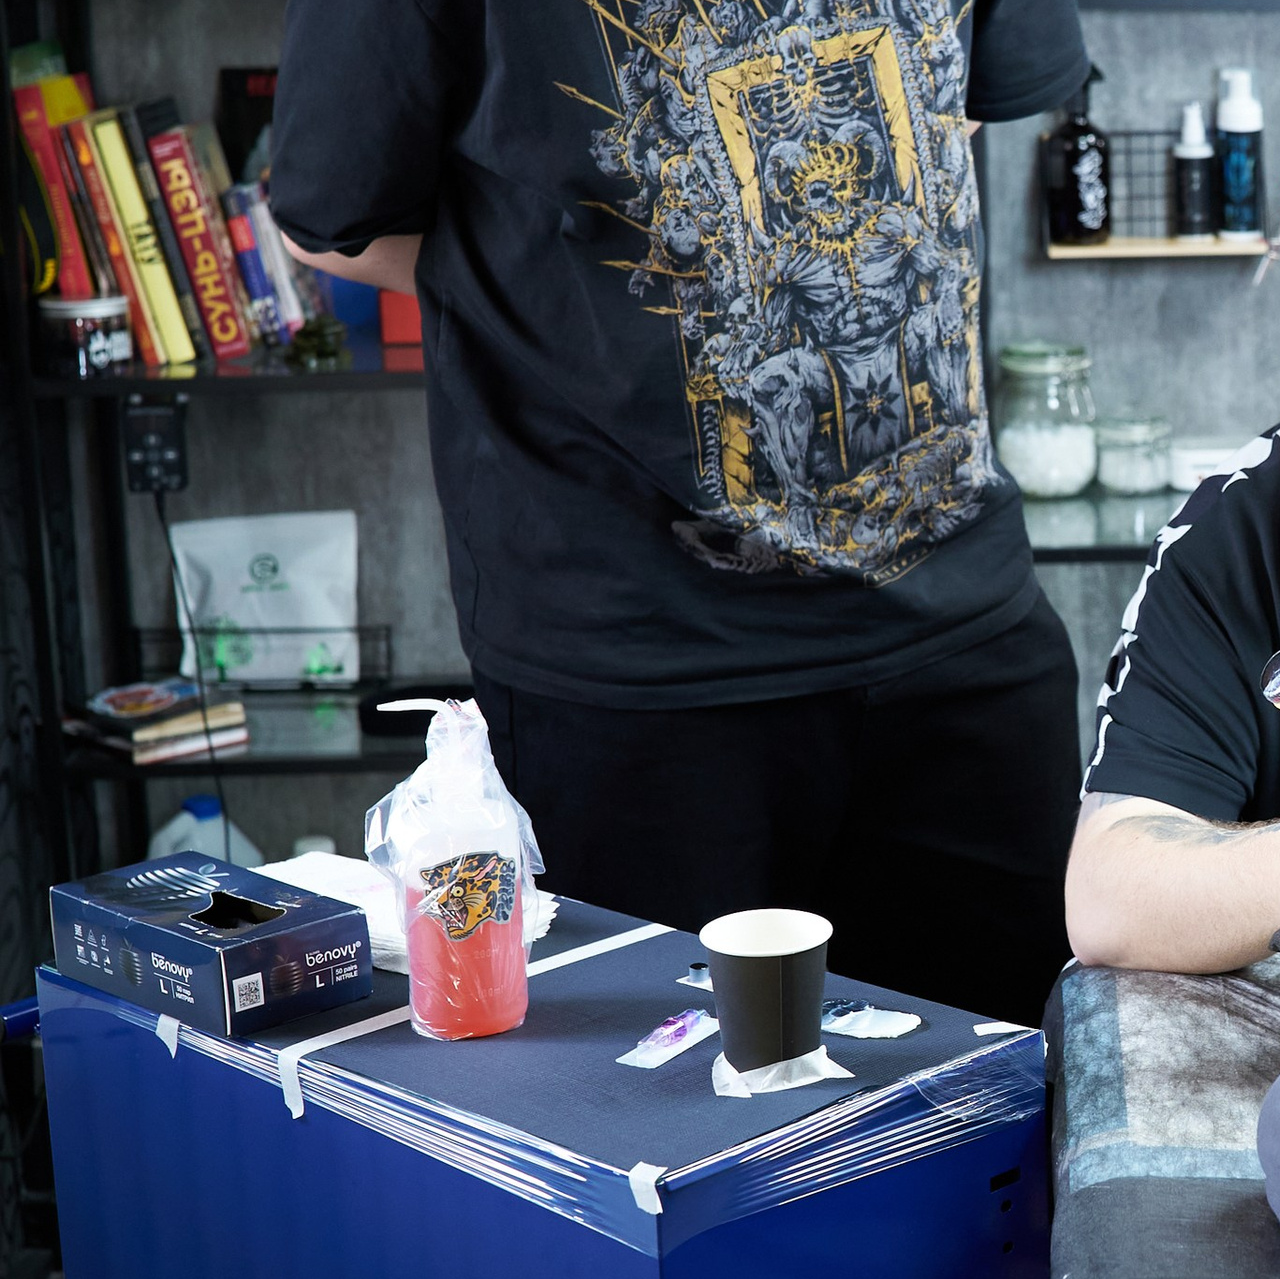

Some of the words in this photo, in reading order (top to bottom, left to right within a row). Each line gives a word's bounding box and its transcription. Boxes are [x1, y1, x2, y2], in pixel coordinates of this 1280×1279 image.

[160, 157, 238, 343] СУНЬ-ЦЗЫ
[305, 943, 357, 967] benovy
[151, 952, 189, 983] benovy
[335, 967, 343, 975] 50
[343, 963, 358, 974] pairs
[335, 969, 358, 982] NITRILE
[315, 974, 325, 988] L
